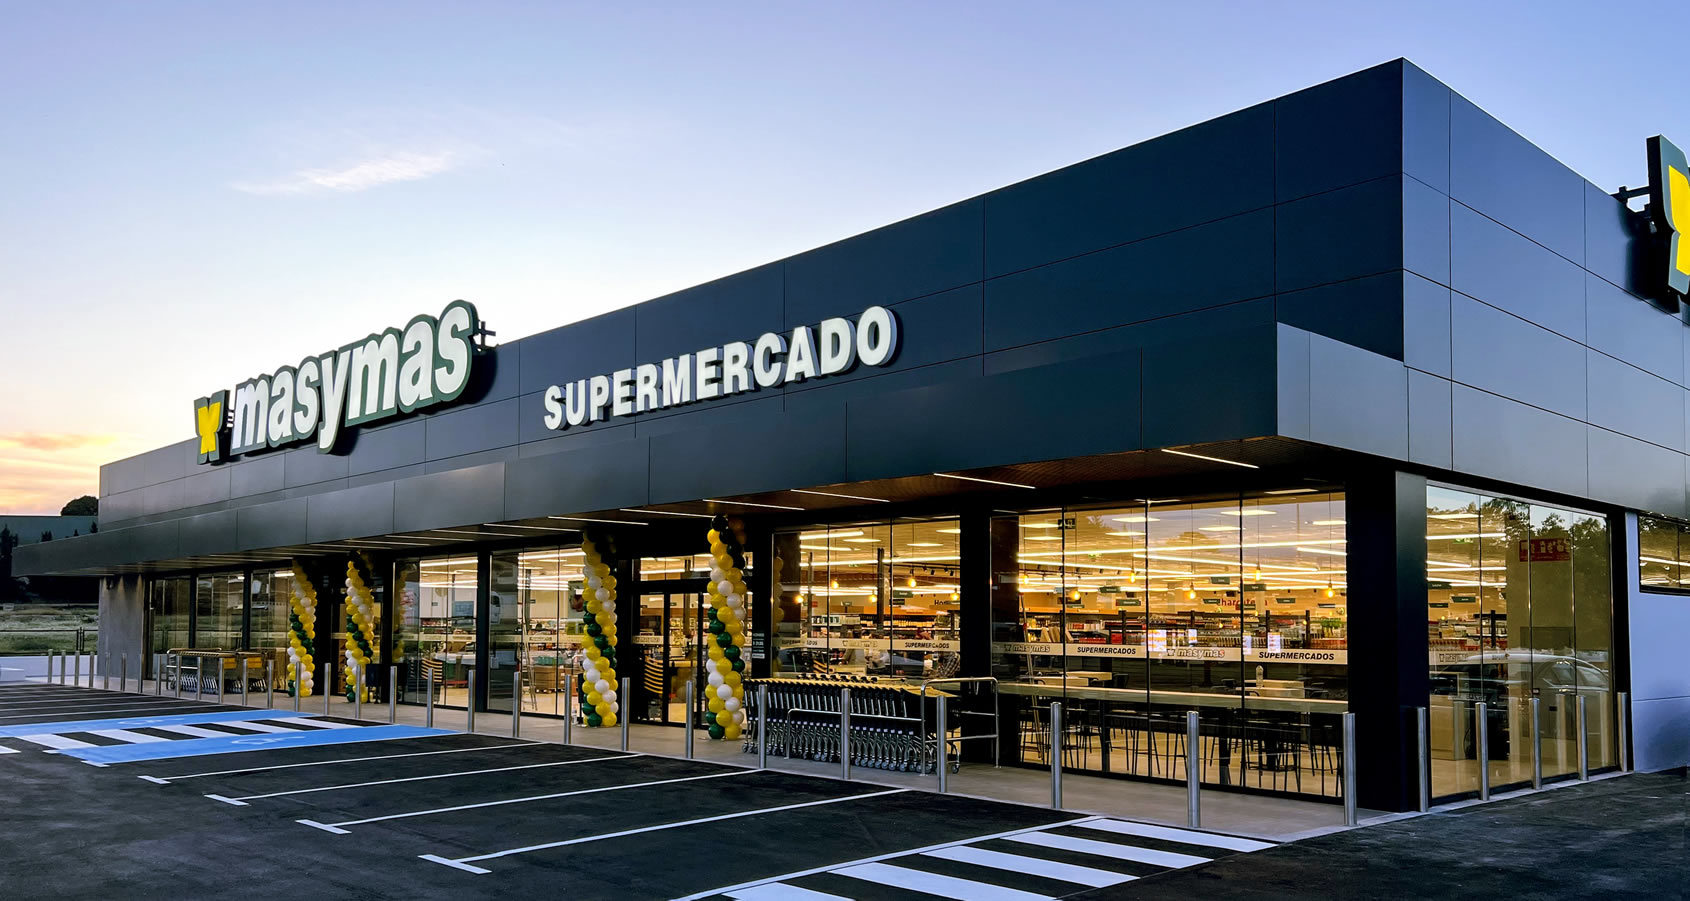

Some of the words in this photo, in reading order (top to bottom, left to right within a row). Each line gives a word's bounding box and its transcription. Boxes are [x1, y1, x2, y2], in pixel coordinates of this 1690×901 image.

[230, 302, 474, 452] masymas
[544, 306, 896, 430] SUPERMERCADO
[1077, 646, 1136, 655] SUPERMERCADOS
[1176, 648, 1225, 659] masymas
[1258, 651, 1335, 661] SUPERMERCADOS
